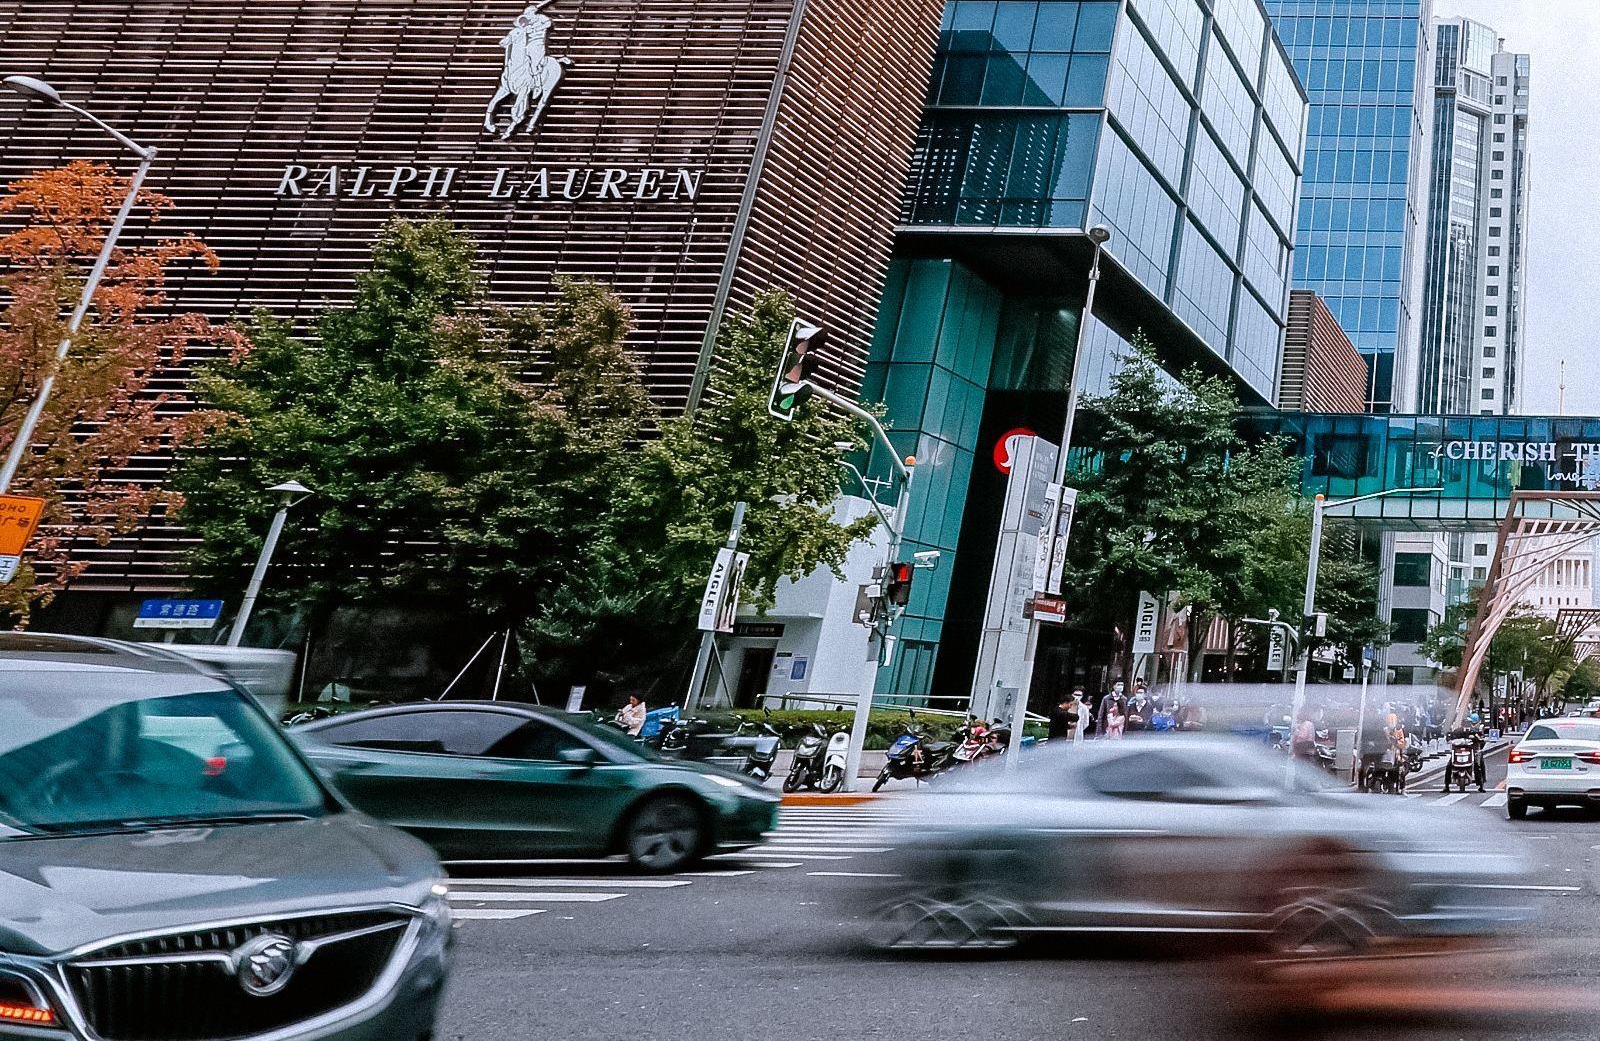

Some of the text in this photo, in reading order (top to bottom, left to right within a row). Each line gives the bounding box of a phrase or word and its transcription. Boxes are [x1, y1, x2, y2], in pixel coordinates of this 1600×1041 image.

[274, 164, 702, 201] RALPH LAUREN
[1445, 440, 1557, 461] CHERISH
[705, 562, 725, 608] AIGLE
[1140, 600, 1155, 636] AIGLE
